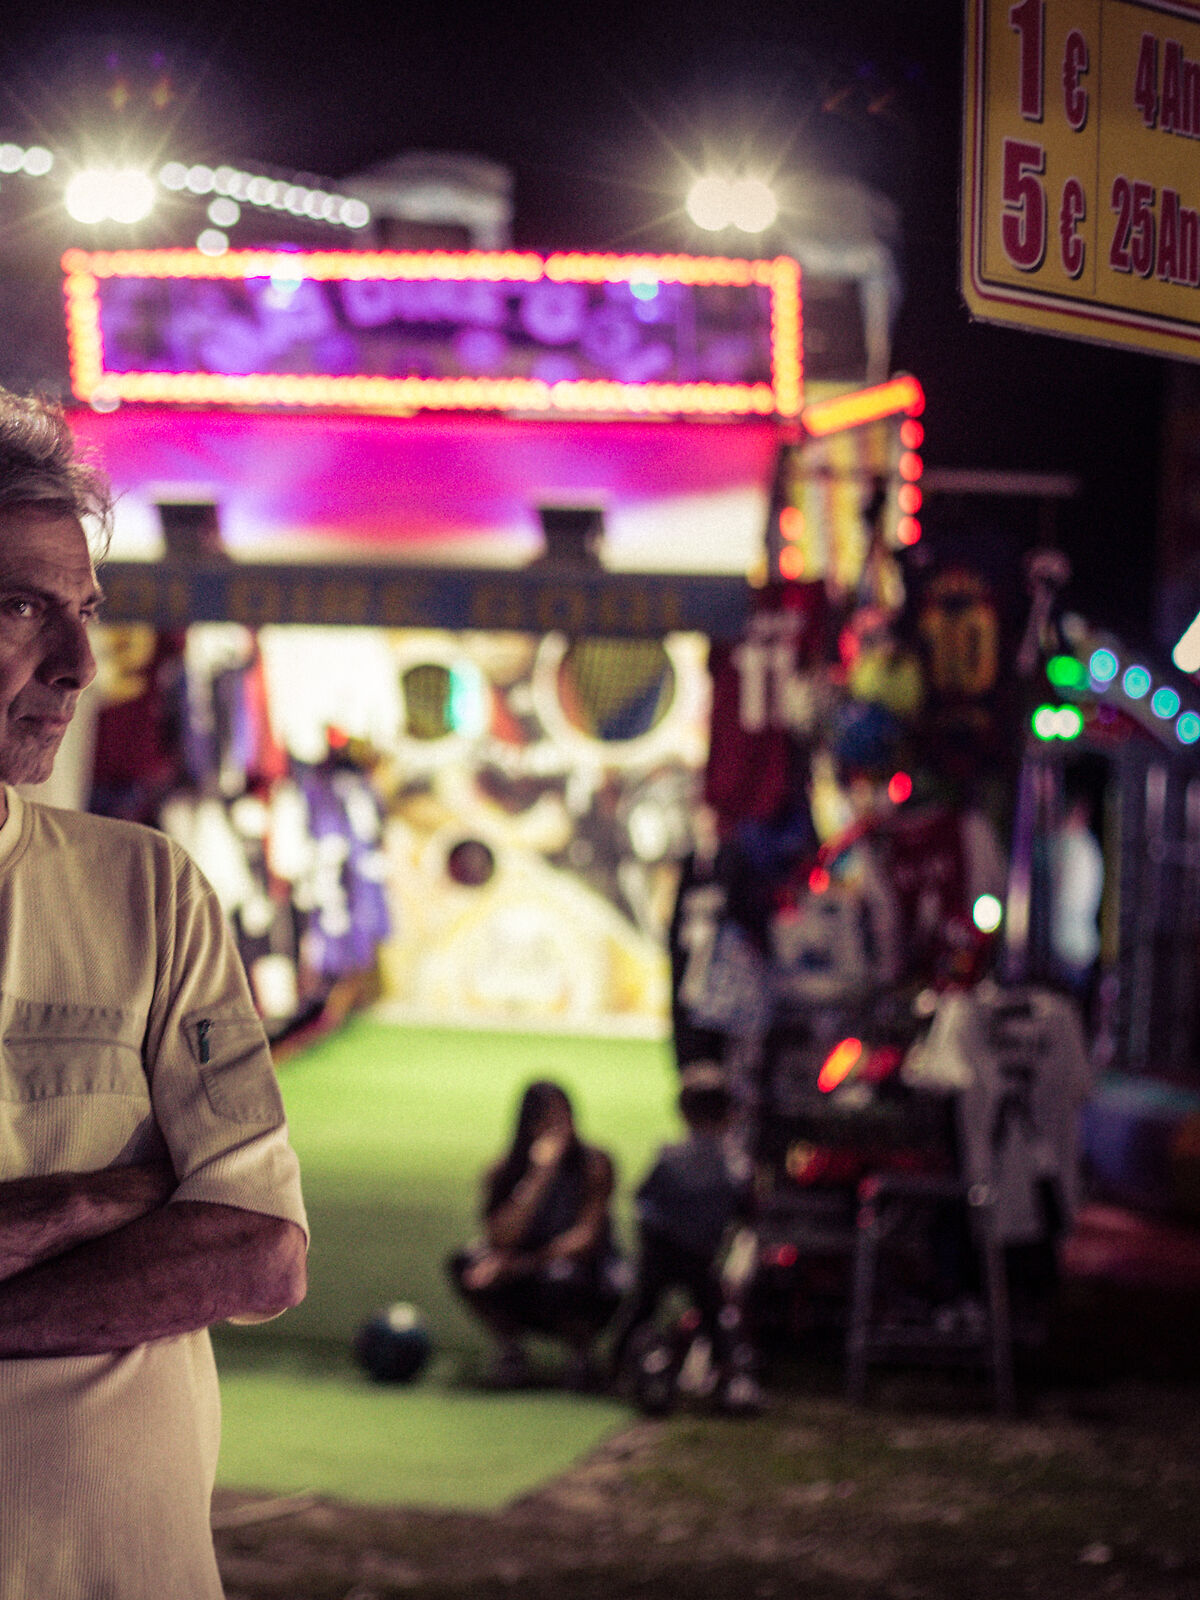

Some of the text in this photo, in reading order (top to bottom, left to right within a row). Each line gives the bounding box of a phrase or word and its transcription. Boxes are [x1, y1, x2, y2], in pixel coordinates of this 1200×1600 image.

[1009, 0, 1044, 120] 1
[1062, 28, 1089, 130] €
[1002, 136, 1046, 272] 5
[1060, 176, 1086, 278] €
